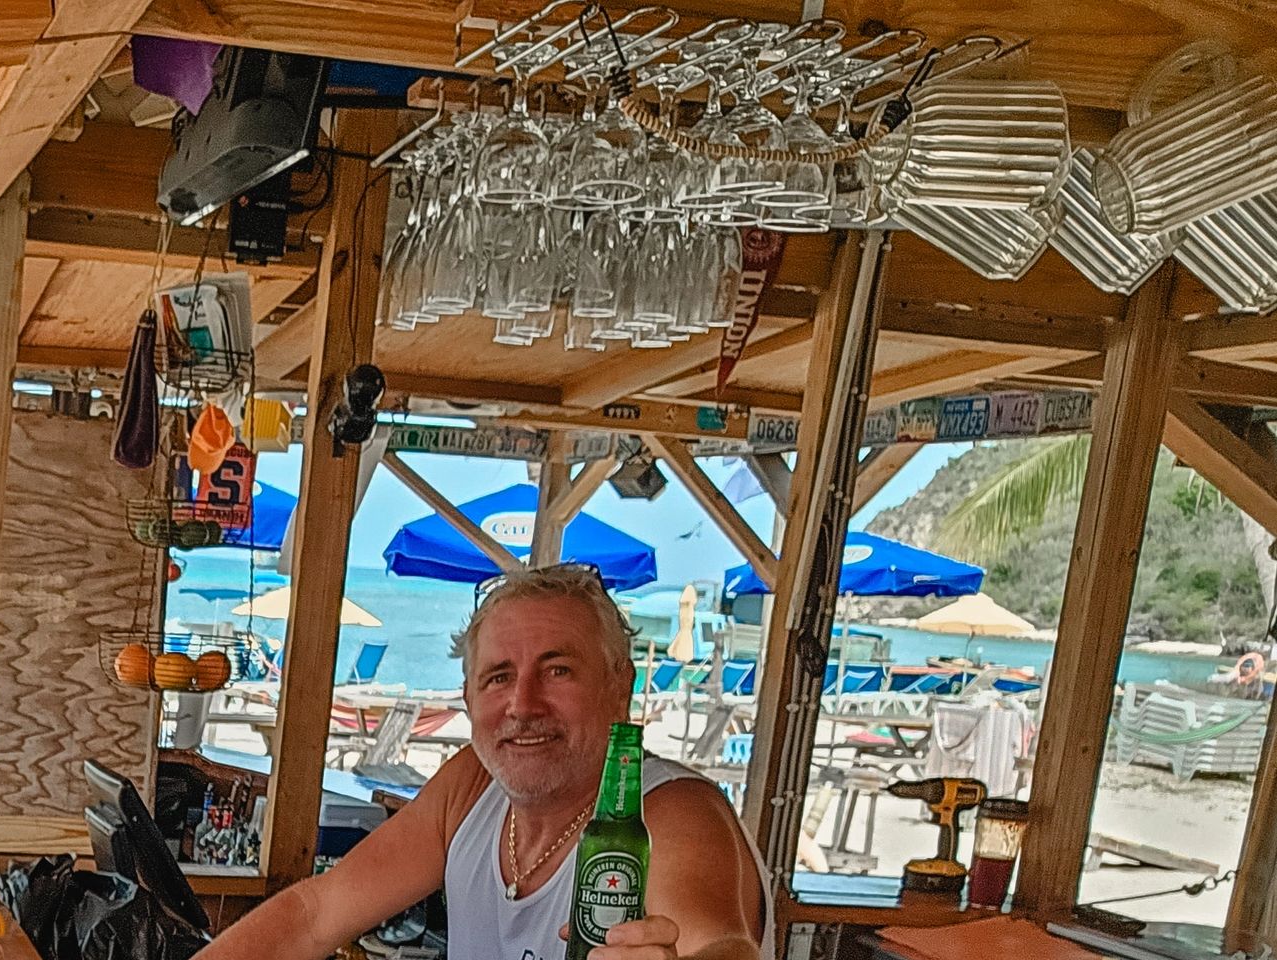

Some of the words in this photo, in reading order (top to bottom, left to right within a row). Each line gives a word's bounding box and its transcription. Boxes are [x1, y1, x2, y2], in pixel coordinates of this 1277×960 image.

[722, 268, 768, 360] UNION
[756, 419, 800, 442] 0626
[581, 889, 639, 906] Heineken
